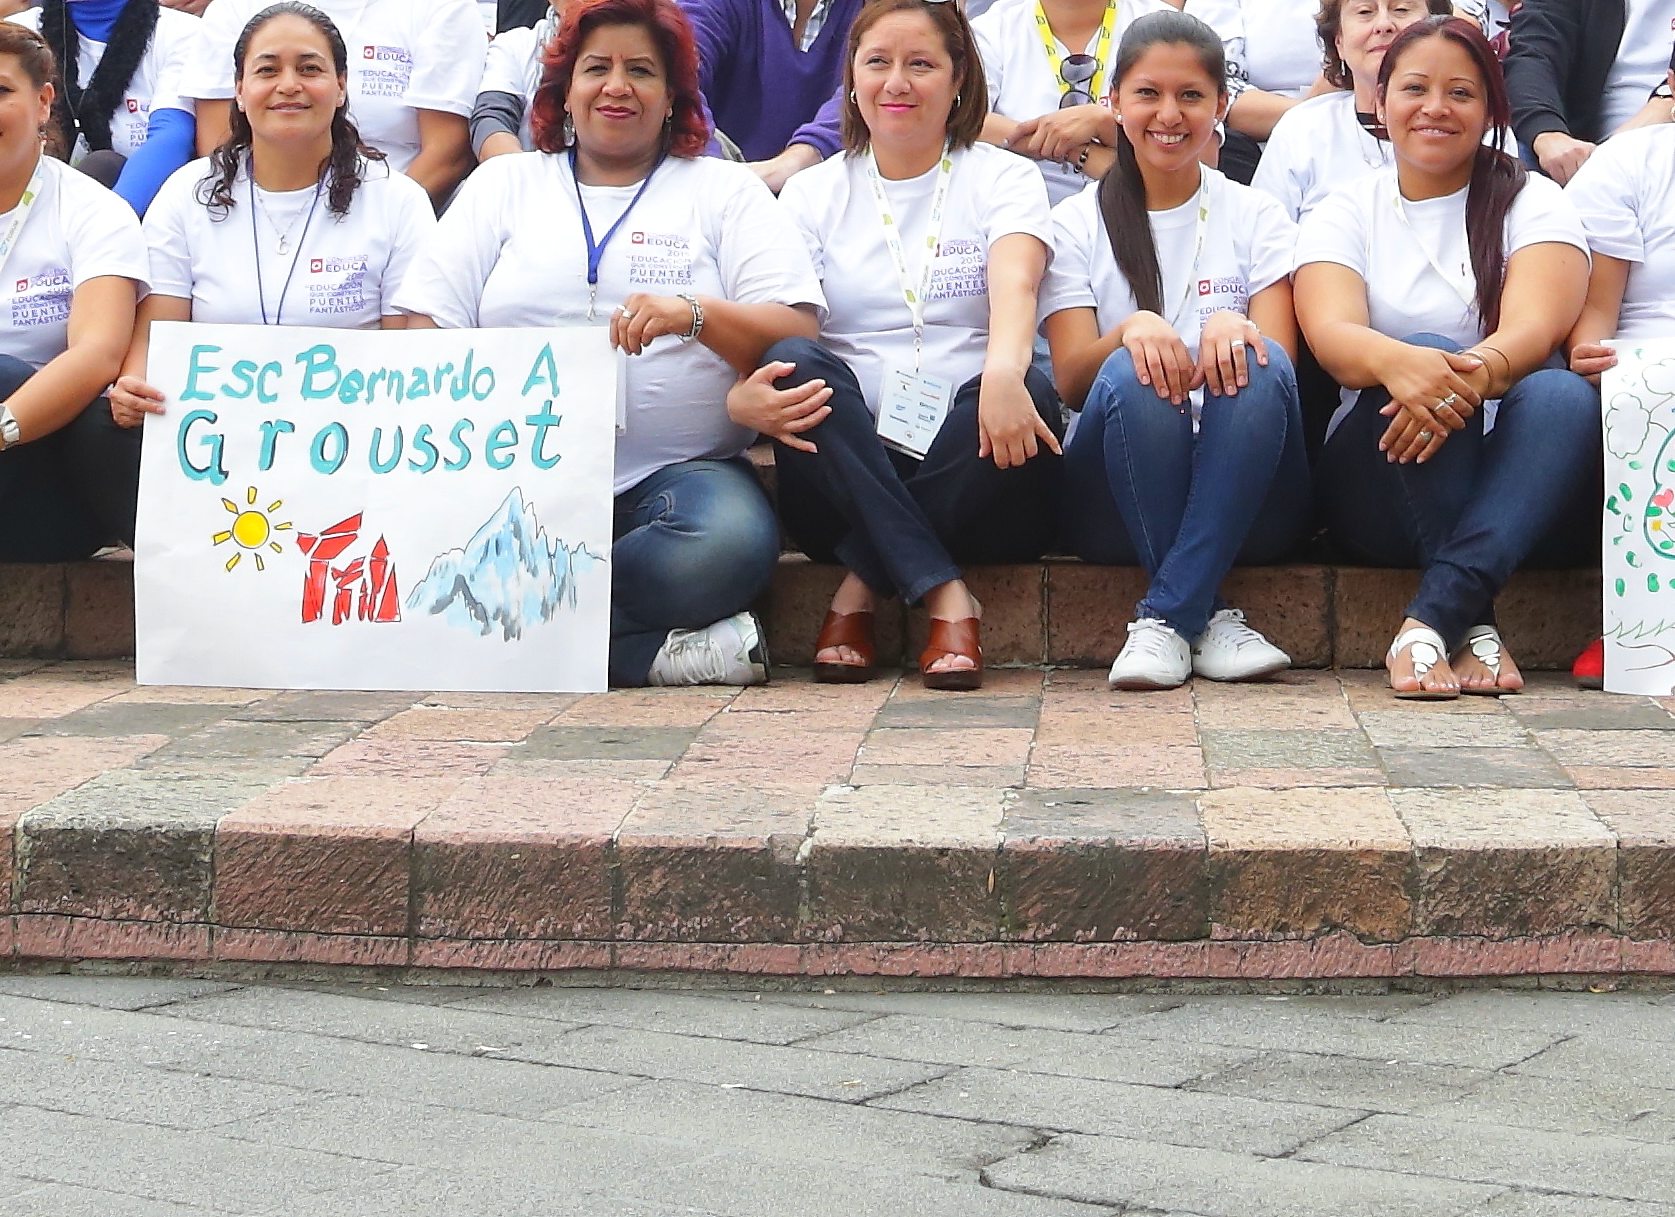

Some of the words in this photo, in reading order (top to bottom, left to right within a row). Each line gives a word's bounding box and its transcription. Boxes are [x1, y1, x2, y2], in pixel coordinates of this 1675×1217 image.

[377, 53, 412, 64] EDUCA
[362, 82, 409, 94] PUENTE
[647, 238, 689, 250] EDUCA
[942, 246, 981, 257] EDUCA
[960, 255, 983, 265] 2015
[326, 262, 368, 273] EDUCA
[934, 265, 986, 278] DUCACIÓN
[630, 268, 692, 279] PUENTES
[1213, 284, 1247, 295] EDUC
[180, 345, 283, 404] Esc
[295, 344, 496, 405] Bernardo
[521, 341, 561, 398] A
[177, 399, 563, 487] Grousset
